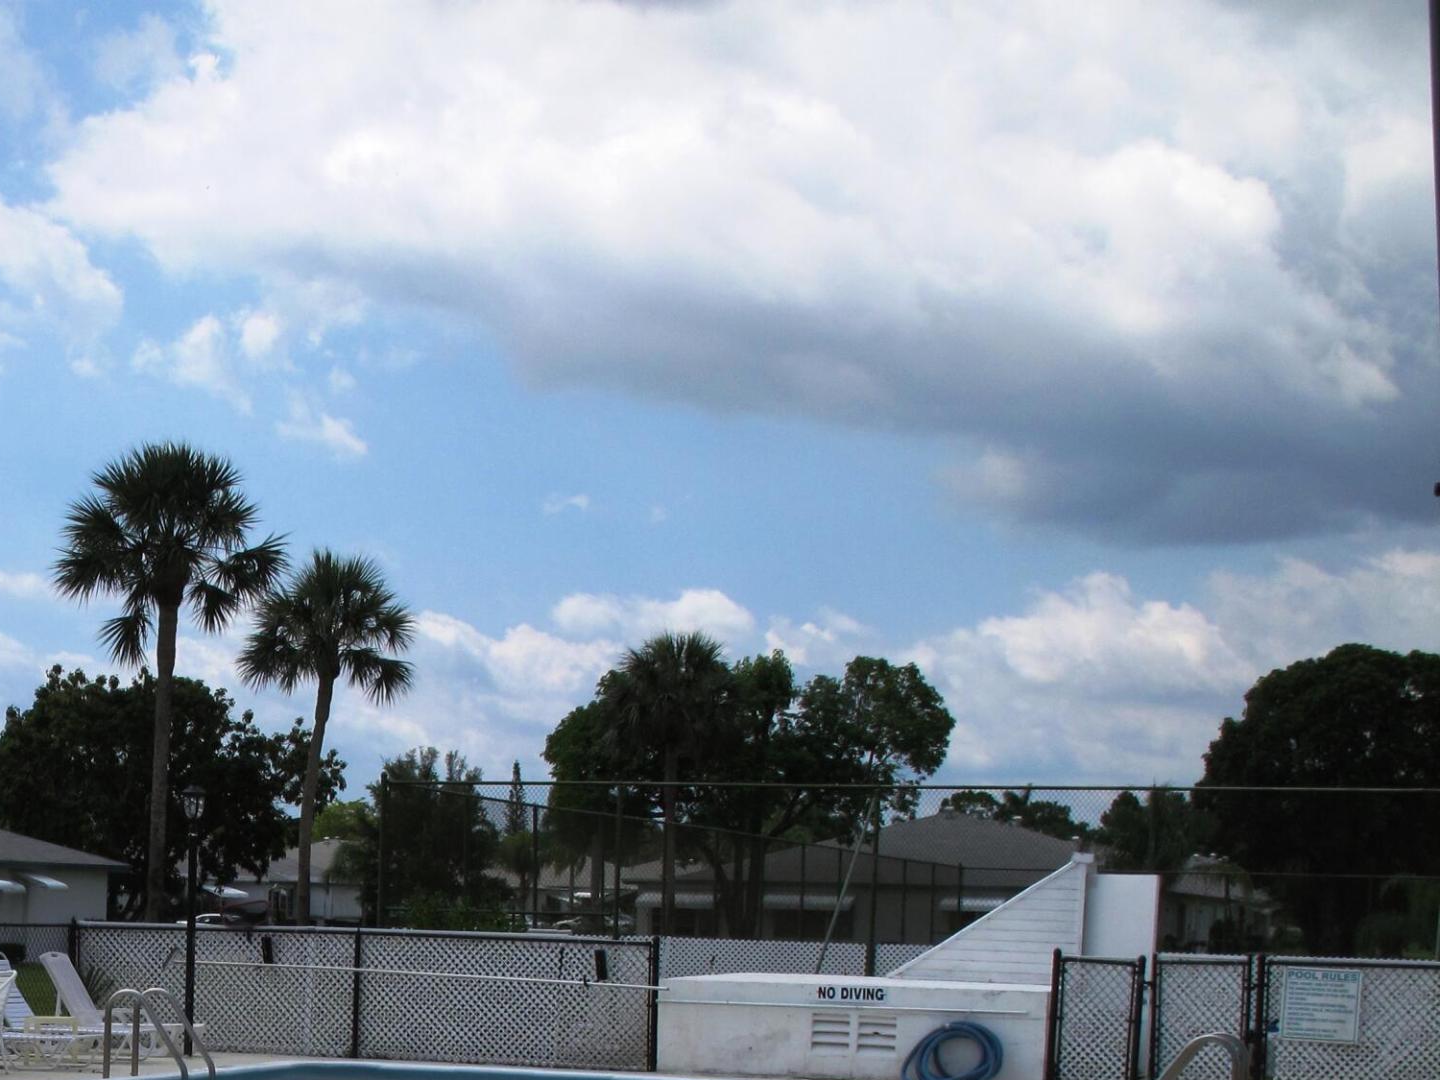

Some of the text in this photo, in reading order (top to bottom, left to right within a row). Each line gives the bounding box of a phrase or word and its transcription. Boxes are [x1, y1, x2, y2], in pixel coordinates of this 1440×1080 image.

[1288, 971, 1358, 982] POOL RULES
[818, 986, 885, 1001] NO DIVING
